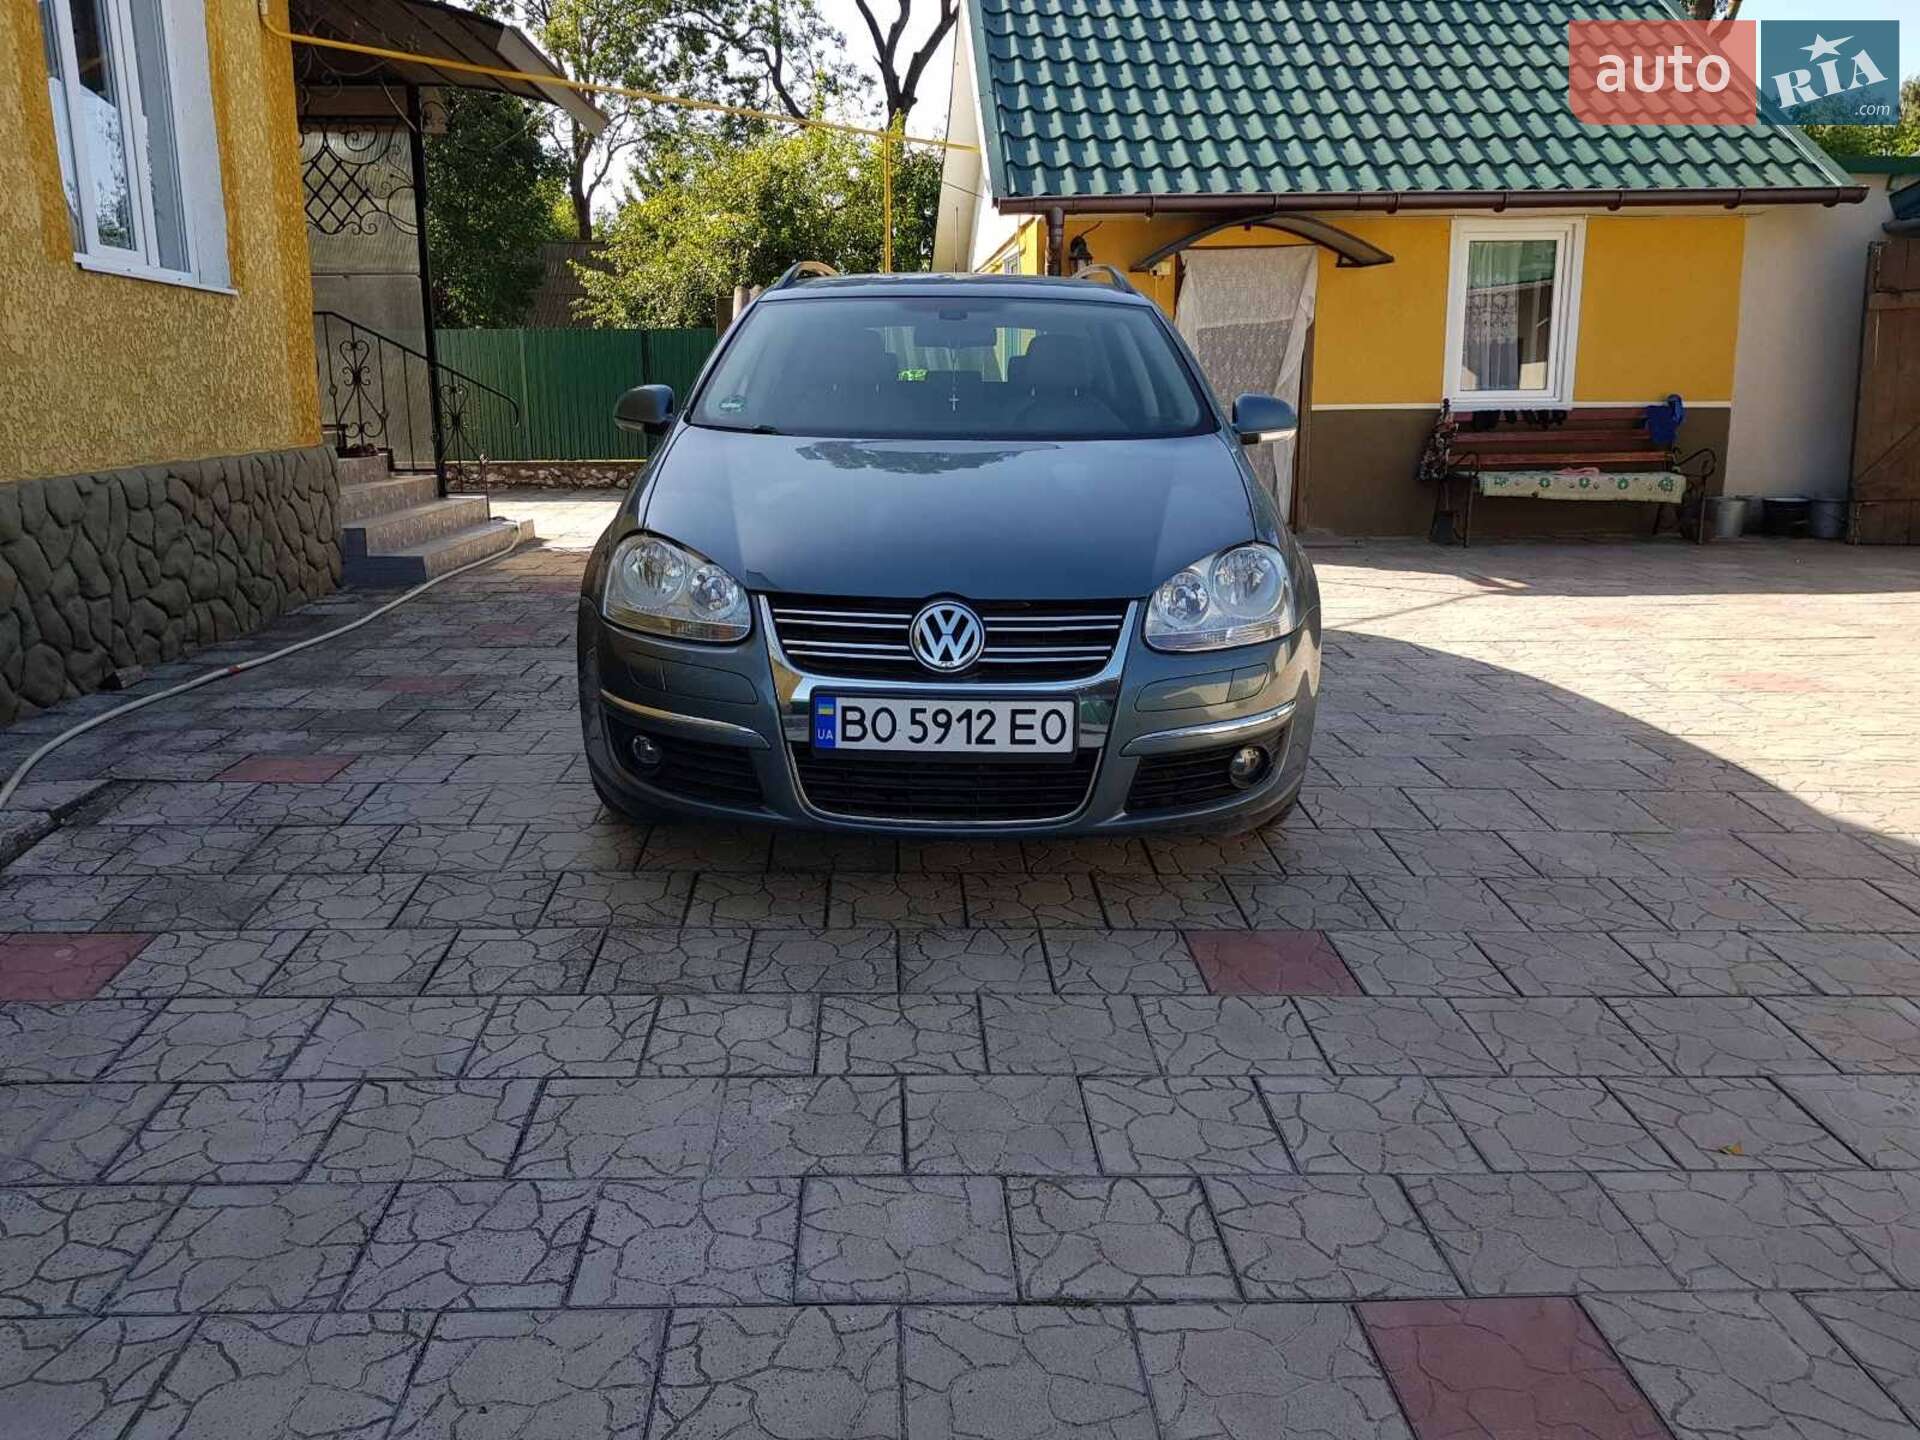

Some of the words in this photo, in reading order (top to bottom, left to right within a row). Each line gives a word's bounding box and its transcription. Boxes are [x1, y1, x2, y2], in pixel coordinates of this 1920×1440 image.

[916, 606, 979, 667] VW
[817, 729, 834, 740] UA
[840, 706, 897, 743] BO
[907, 707, 997, 745] 5912
[1009, 708, 1067, 745] EO
